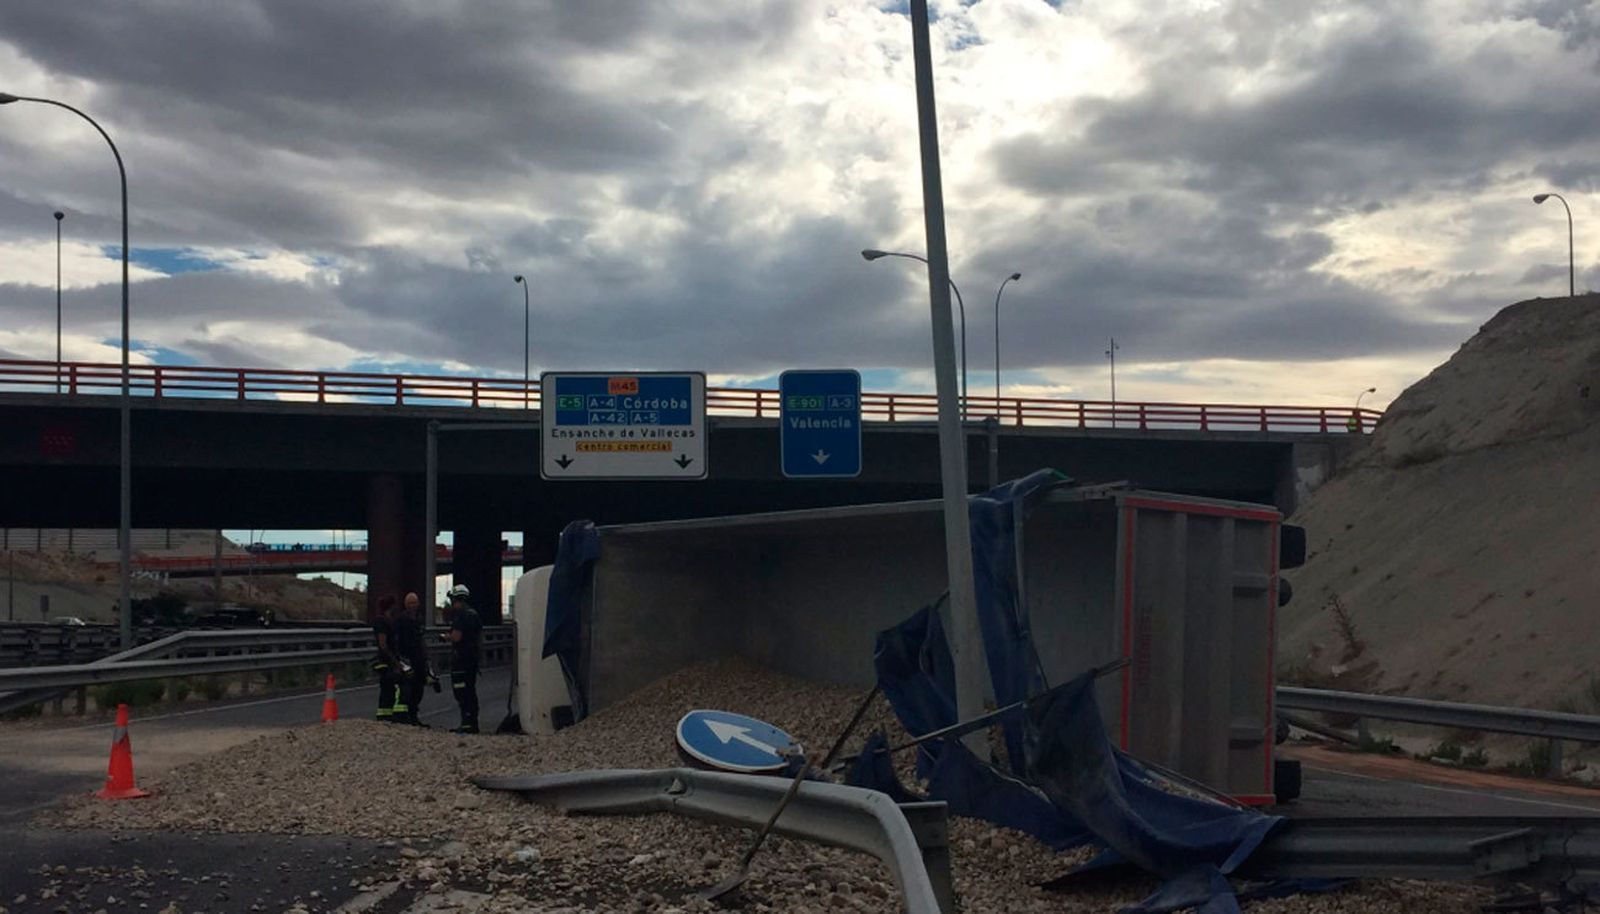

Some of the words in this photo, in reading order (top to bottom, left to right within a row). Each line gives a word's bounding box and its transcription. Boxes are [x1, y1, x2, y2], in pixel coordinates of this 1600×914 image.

[559, 397, 582, 408] E-5
[590, 397, 614, 408] A-4
[623, 396, 688, 409] Córdoba
[831, 398, 852, 408] A-3
[591, 412, 625, 423] A-42
[633, 412, 657, 423] A-5
[789, 416, 852, 428] Valencia
[551, 428, 615, 438] Ensanche
[620, 428, 634, 438] de
[641, 428, 696, 438] Vallecas
